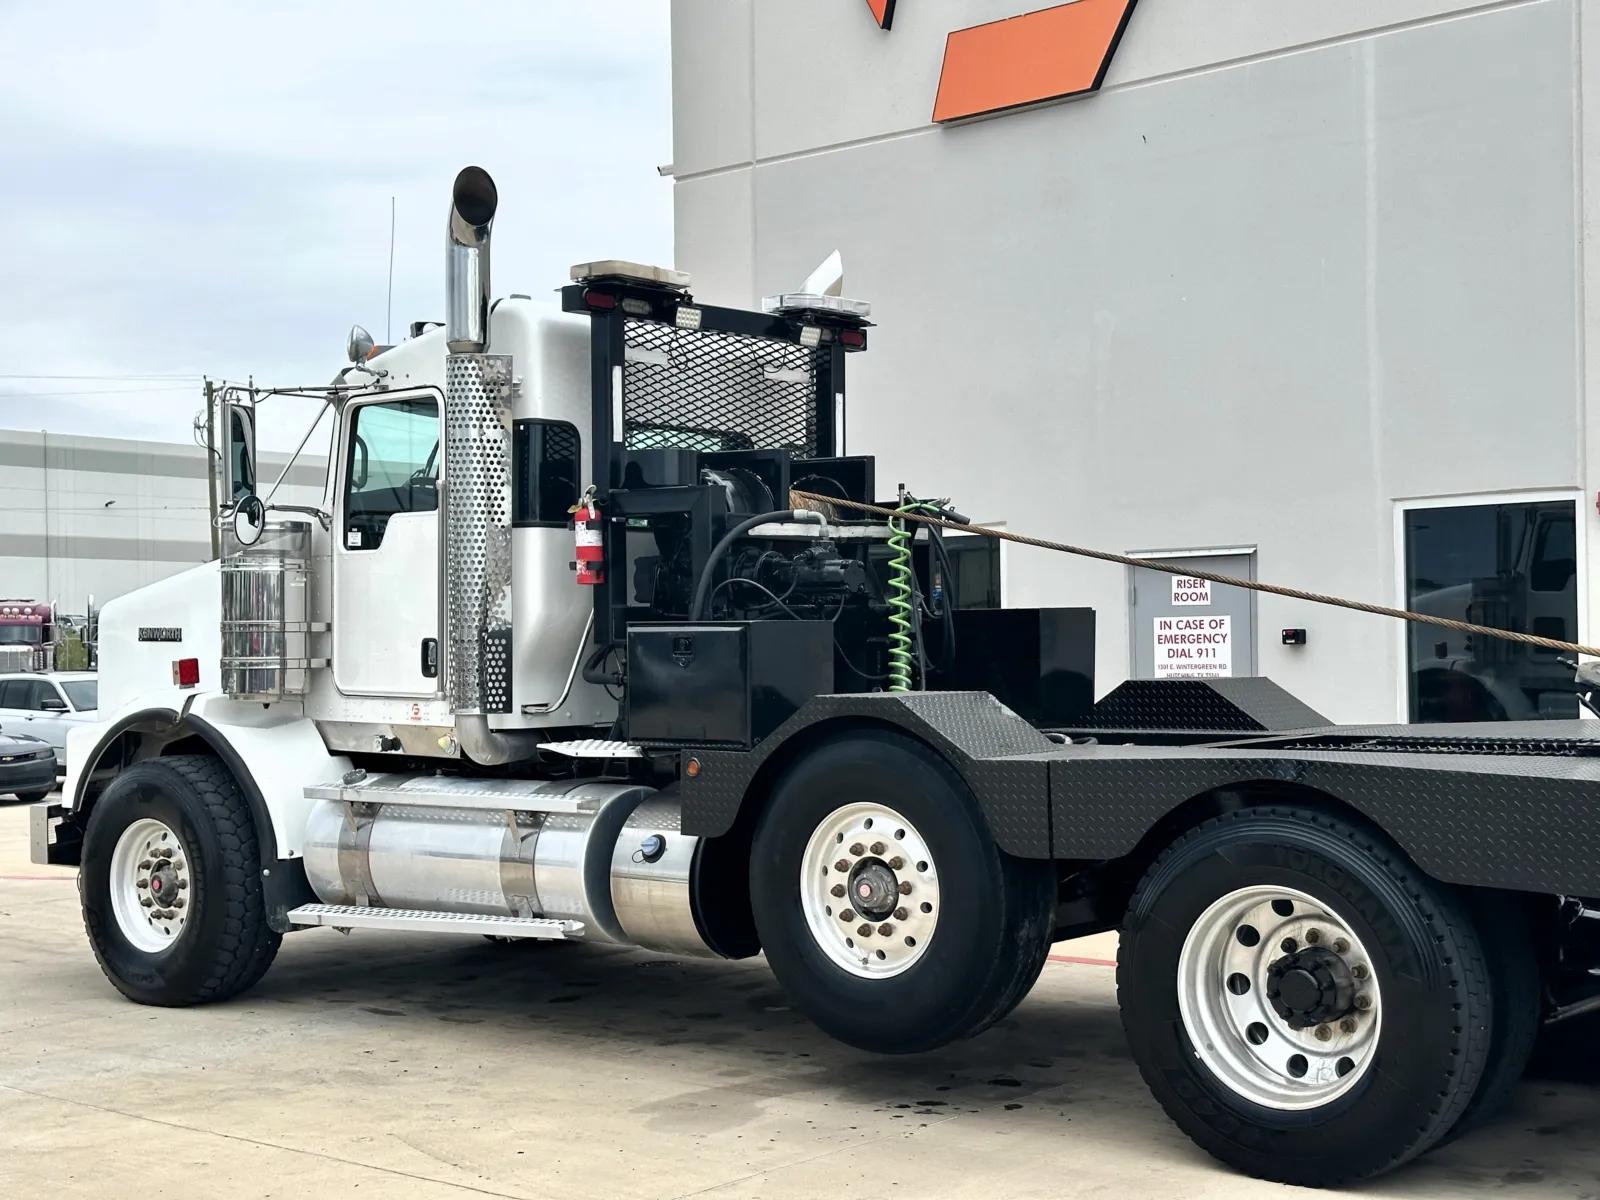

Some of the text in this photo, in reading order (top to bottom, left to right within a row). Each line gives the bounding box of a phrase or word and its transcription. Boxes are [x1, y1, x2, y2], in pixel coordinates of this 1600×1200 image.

[1176, 578, 1206, 589] RISER
[1174, 592, 1209, 602] ROOM
[1159, 618, 1225, 630] IN CASE OF
[139, 628, 182, 639] KENWORTH
[1157, 633, 1228, 645] EMERGENCY
[1167, 648, 1216, 659] DIAL 911
